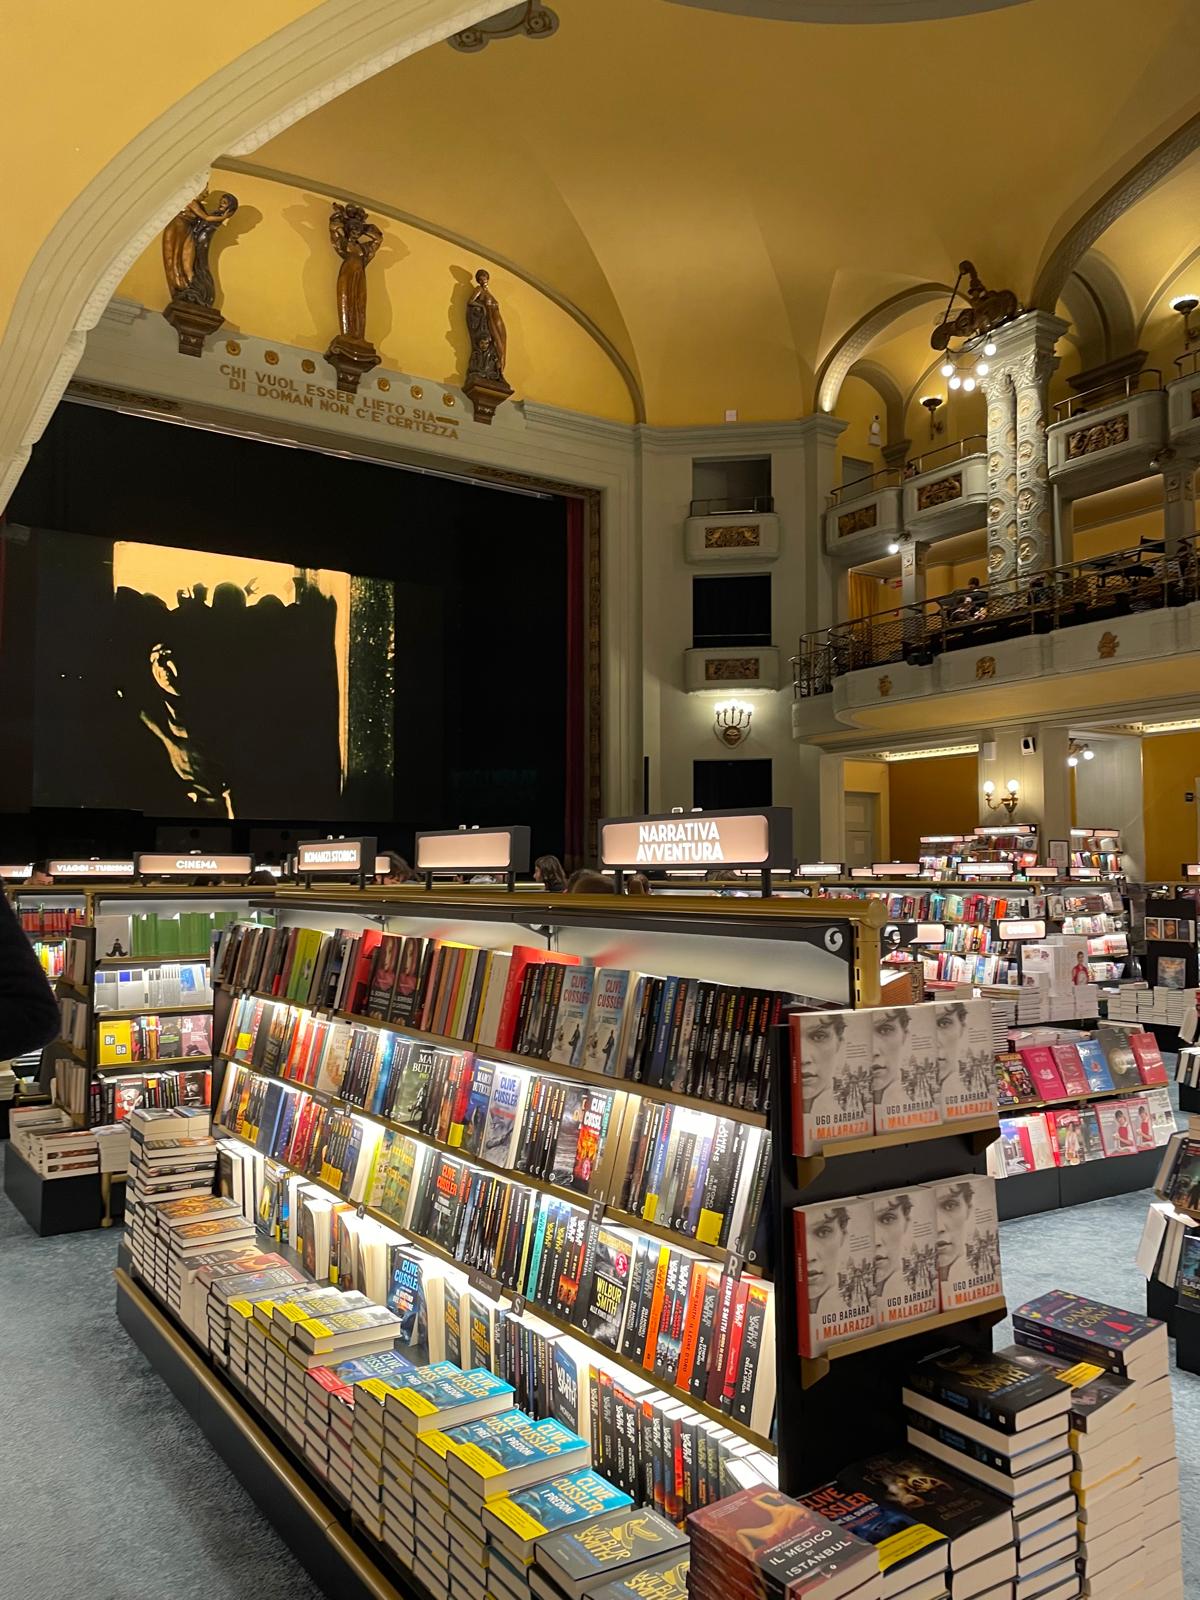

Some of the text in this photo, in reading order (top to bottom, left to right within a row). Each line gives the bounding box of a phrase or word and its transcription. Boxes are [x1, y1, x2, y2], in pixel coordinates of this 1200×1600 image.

[219, 364, 437, 424] CHI VUOL ESSER LIETO SIA
[229, 378, 246, 393] DI
[257, 385, 313, 408] DOMAN
[320, 399, 349, 416] NON
[386, 414, 459, 440] CERTEZZA
[639, 821, 720, 843] NARRATIVA
[636, 841, 724, 862] AVVENTURA
[56, 864, 89, 873] VIAGGI
[176, 860, 218, 870] CINEMA
[571, 975, 589, 990] CLIVE
[605, 979, 622, 994] CLIVE
[500, 1076, 518, 1092] CLIVE
[493, 1088, 518, 1107] CUSSLER
[945, 1095, 959, 1105] UGO
[886, 1106, 901, 1115] UGO
[946, 1101, 993, 1117] MALARAZZA
[583, 1111, 602, 1130] CUSS
[815, 1115, 831, 1126] UGO
[887, 1110, 940, 1128] MALARAZZA
[816, 1121, 869, 1140] MALARAZZA
[441, 1164, 456, 1181] CLIVE
[436, 1175, 458, 1196] CUSSLER
[592, 1203, 600, 1221] E
[401, 1259, 419, 1277] CLIVE
[728, 1255, 738, 1276] R
[596, 1276, 622, 1303] WILBUR
[952, 1281, 966, 1291] UGO
[955, 1283, 1000, 1306] MALARAZZA
[514, 1298, 521, 1314] S
[596, 1294, 618, 1316] SMITH
[887, 1297, 901, 1307] UGO
[888, 1302, 936, 1321] MALARAZZA
[719, 1307, 729, 1334] SMITH
[822, 1314, 837, 1324] UGO
[823, 1318, 875, 1338] MALARAZZA
[379, 1353, 404, 1370] CLIVE
[416, 1365, 440, 1382] CUSS
[433, 1365, 450, 1378] CLI
[468, 1372, 500, 1390] CLIVE
[440, 1383, 465, 1399] PREDONI
[447, 1373, 489, 1398] CUSSLER
[482, 1416, 511, 1435] CUSS
[503, 1414, 518, 1428] CLI
[514, 1424, 562, 1455] CUSSLER
[536, 1424, 575, 1445] CLIVE
[505, 1435, 536, 1457] PREDONI
[552, 1478, 605, 1514] CUSSLER
[576, 1476, 618, 1500] CLIVE
[543, 1492, 577, 1515] PREDONI
[819, 1491, 874, 1519] SSLER
[574, 1532, 617, 1561] SMITH
[582, 1524, 632, 1561] WILBUR
[769, 1556, 786, 1566] IL
[785, 1529, 833, 1561] MEDICO
[785, 1539, 853, 1578] ISTANBUL
